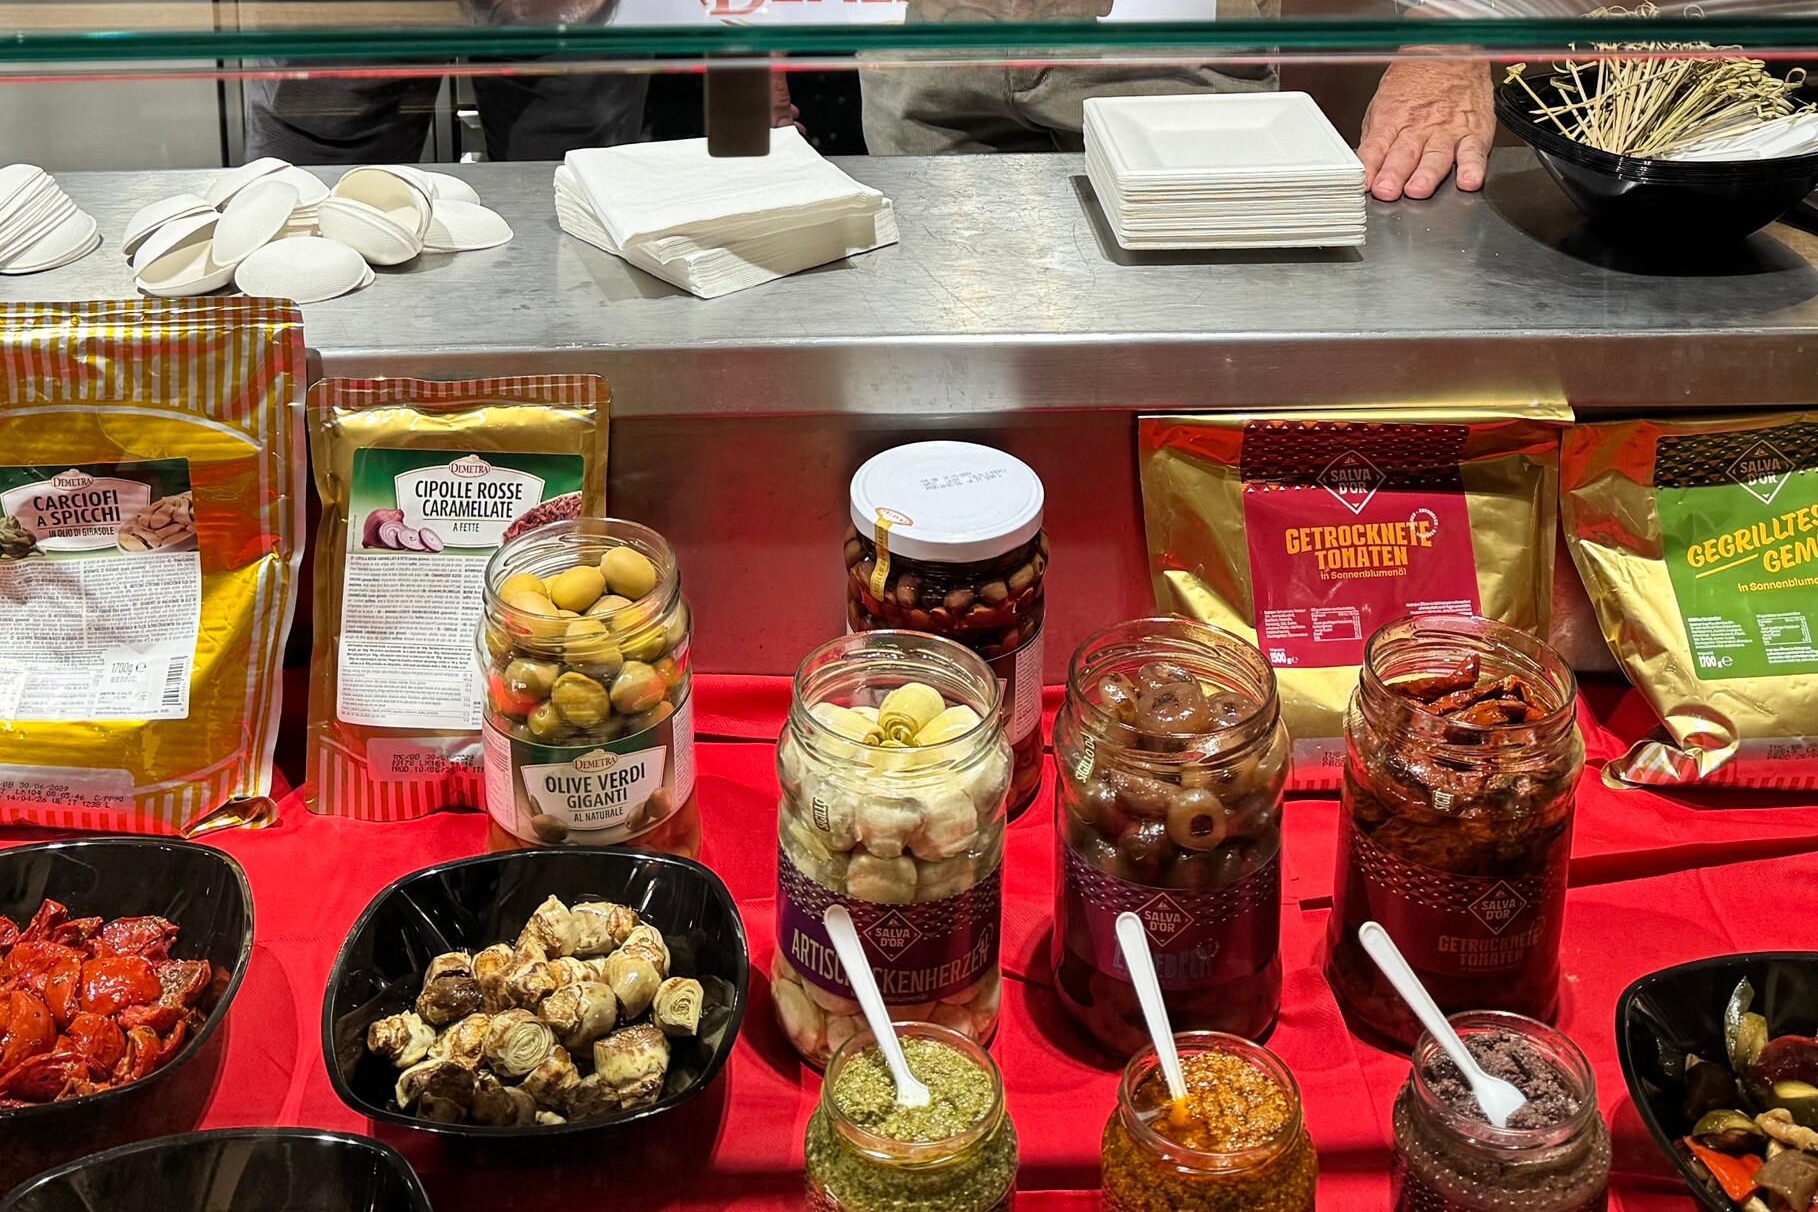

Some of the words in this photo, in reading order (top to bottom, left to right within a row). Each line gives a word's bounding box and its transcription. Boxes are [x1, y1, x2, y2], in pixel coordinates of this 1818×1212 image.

[450, 463, 489, 474] DEMETRA
[1740, 458, 1781, 473] SALVA
[1331, 468, 1372, 482] SALVA
[1747, 472, 1777, 486] D'OR
[53, 477, 93, 488] DEMETRA
[1338, 481, 1368, 495] D'OR
[415, 480, 472, 499] CIPOLLE
[477, 482, 523, 500] ROSSE
[33, 489, 118, 511] CARCIOFI
[422, 499, 513, 518] CARAMELLATE
[37, 515, 47, 527] A
[50, 506, 120, 526] SPICCHI
[48, 530, 57, 538] IN
[57, 528, 73, 538] OLIO
[74, 528, 81, 537] DI
[82, 526, 114, 537] GIRASOLE
[453, 523, 458, 532] A
[459, 523, 480, 532] FETTE
[1285, 521, 1432, 555] GETROCKNETE
[1315, 546, 1408, 570] TOMATEN
[1320, 571, 1329, 580] in
[1331, 567, 1407, 580] Sonnenblumenöl
[1738, 583, 1749, 592] in
[575, 752, 618, 770] DEMETRA
[545, 776, 592, 794] OLIVE
[597, 762, 645, 790] VERDI
[567, 788, 628, 809] GIGANTI
[574, 813, 584, 822] AL
[585, 807, 624, 822] NATURALE
[1481, 899, 1516, 911] SALVA
[1144, 910, 1181, 923] SALVA
[1486, 910, 1510, 920] D'OR
[875, 927, 911, 938] SALVA
[1150, 922, 1175, 933] D'OR
[880, 938, 904, 948] D'OR
[791, 928, 990, 995] ARTISCCKENHERZEN
[1459, 950, 1523, 966] TOMATEN
